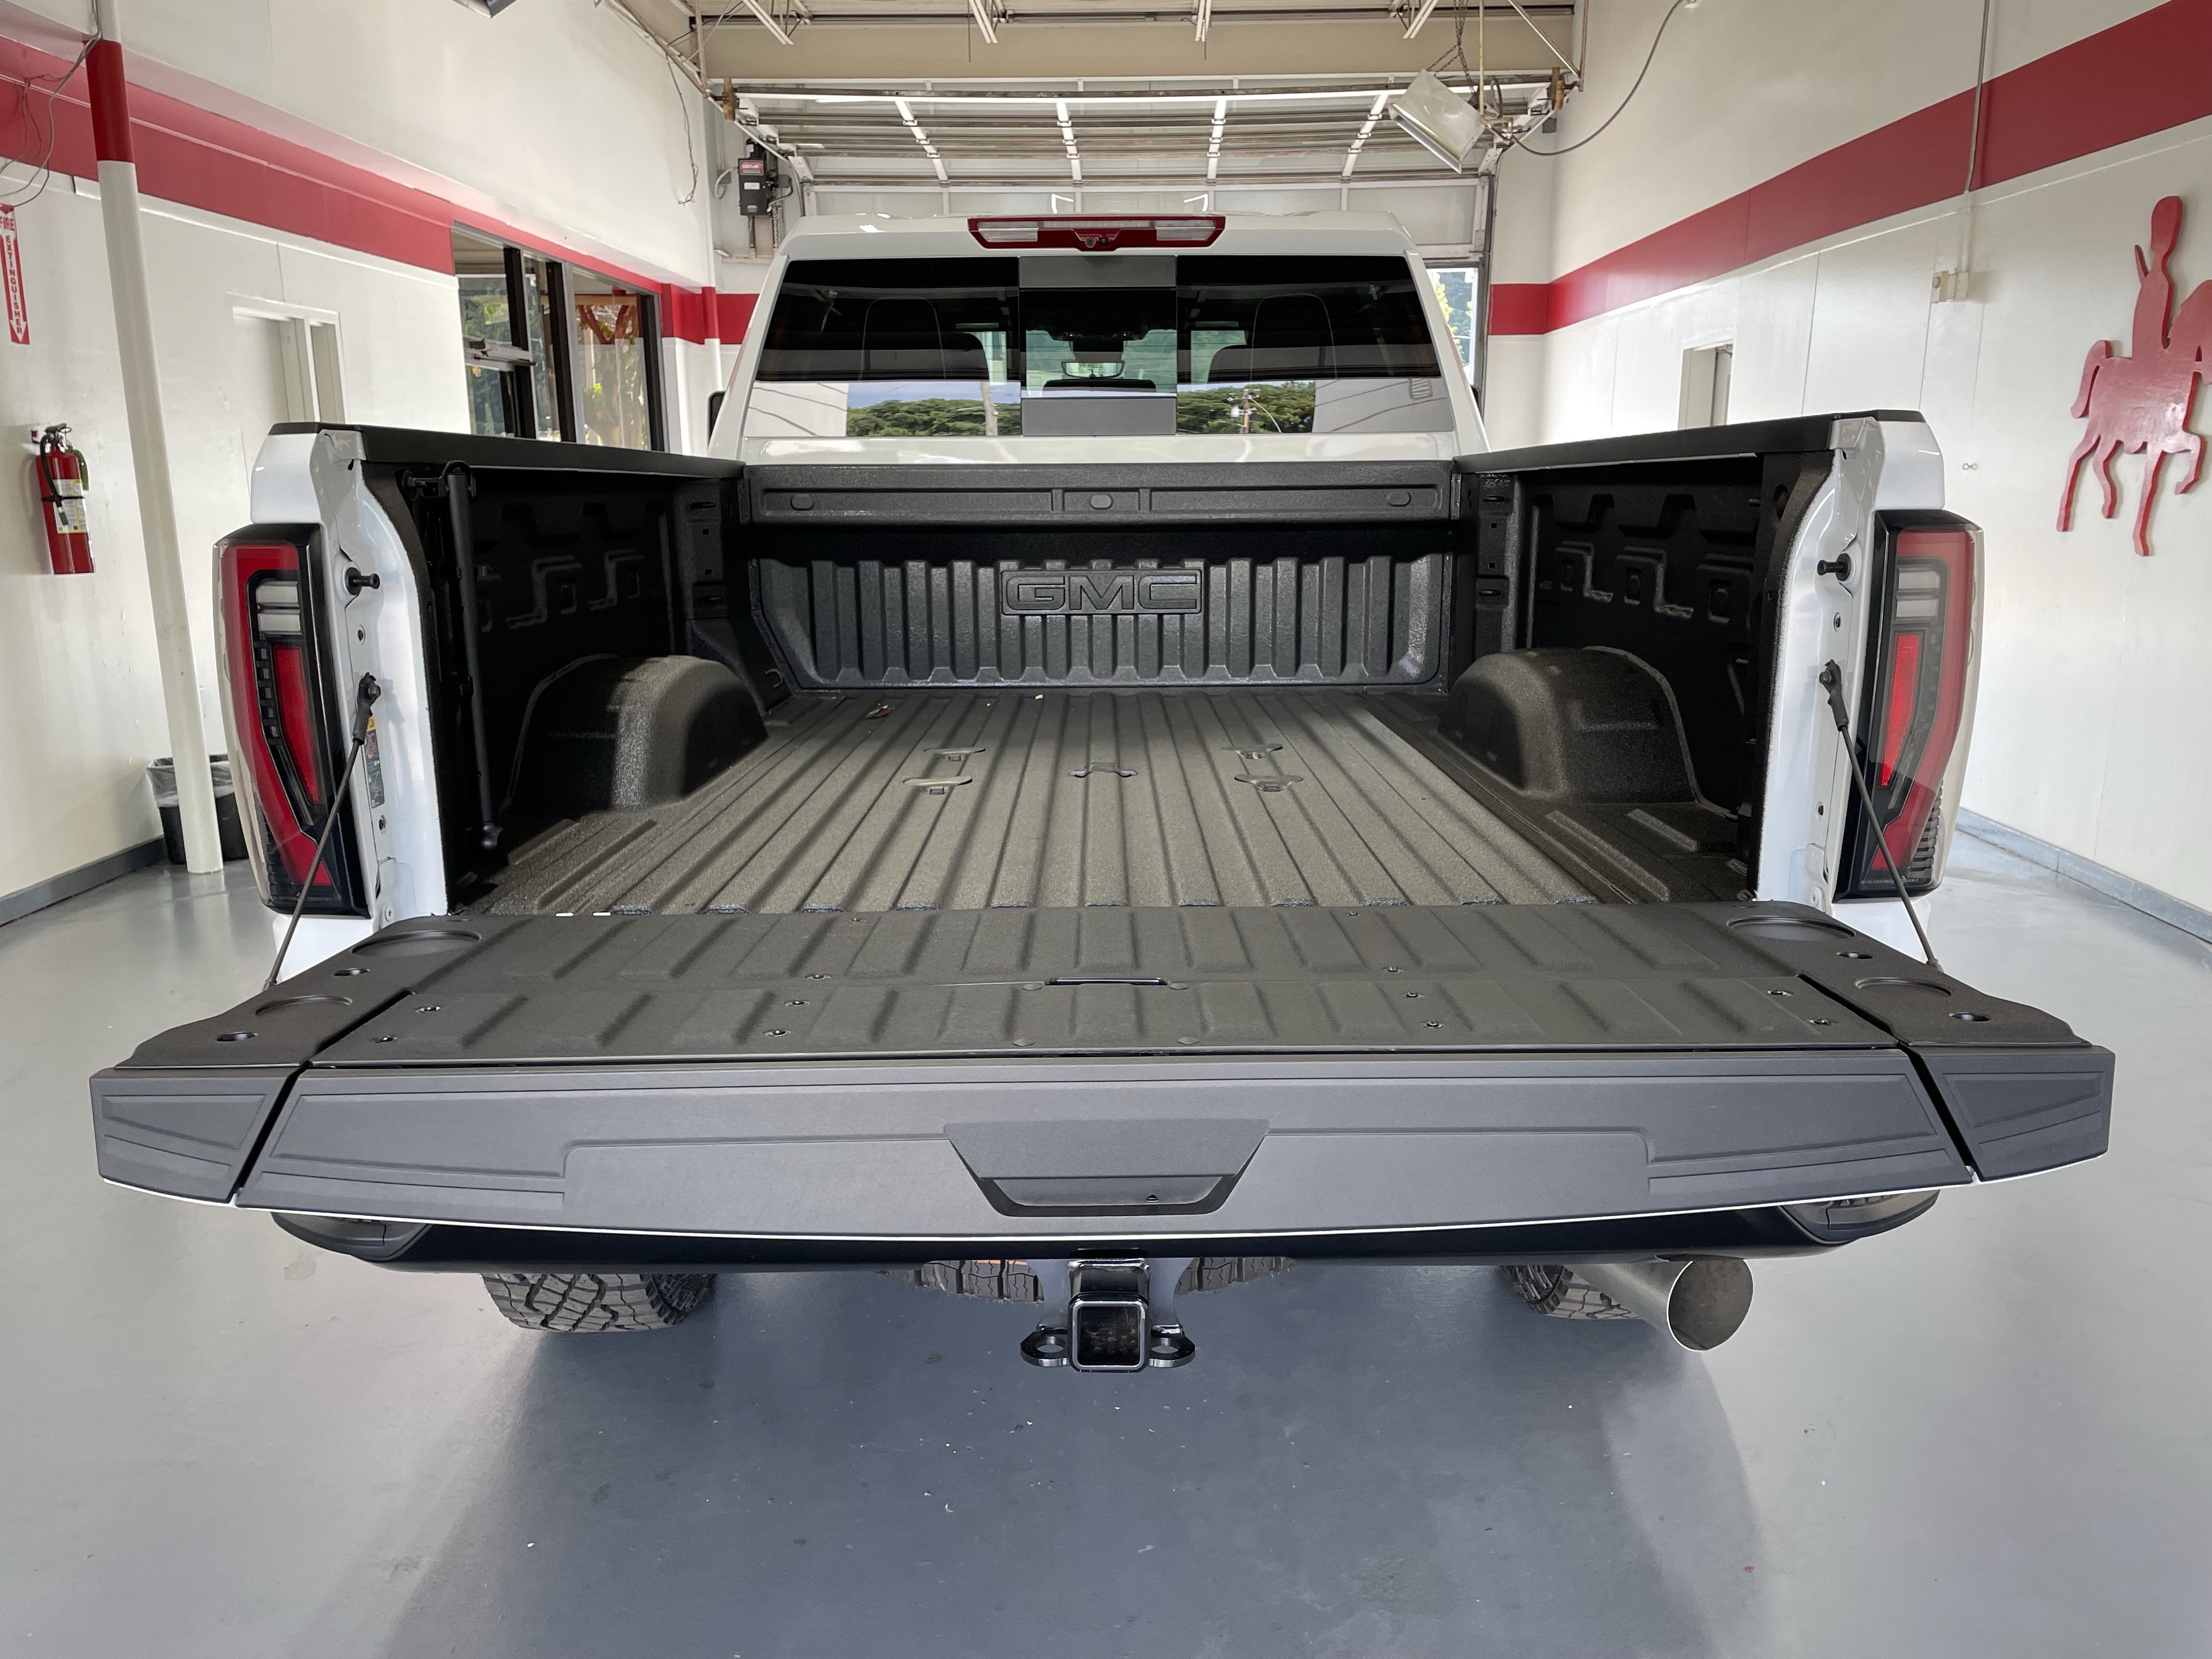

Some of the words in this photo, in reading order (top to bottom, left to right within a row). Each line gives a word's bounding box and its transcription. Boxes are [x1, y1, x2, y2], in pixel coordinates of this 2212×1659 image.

[0, 216, 14, 231] FIRE
[5, 235, 22, 334] EXTINGUISHER
[1006, 574, 1198, 611] GMC
